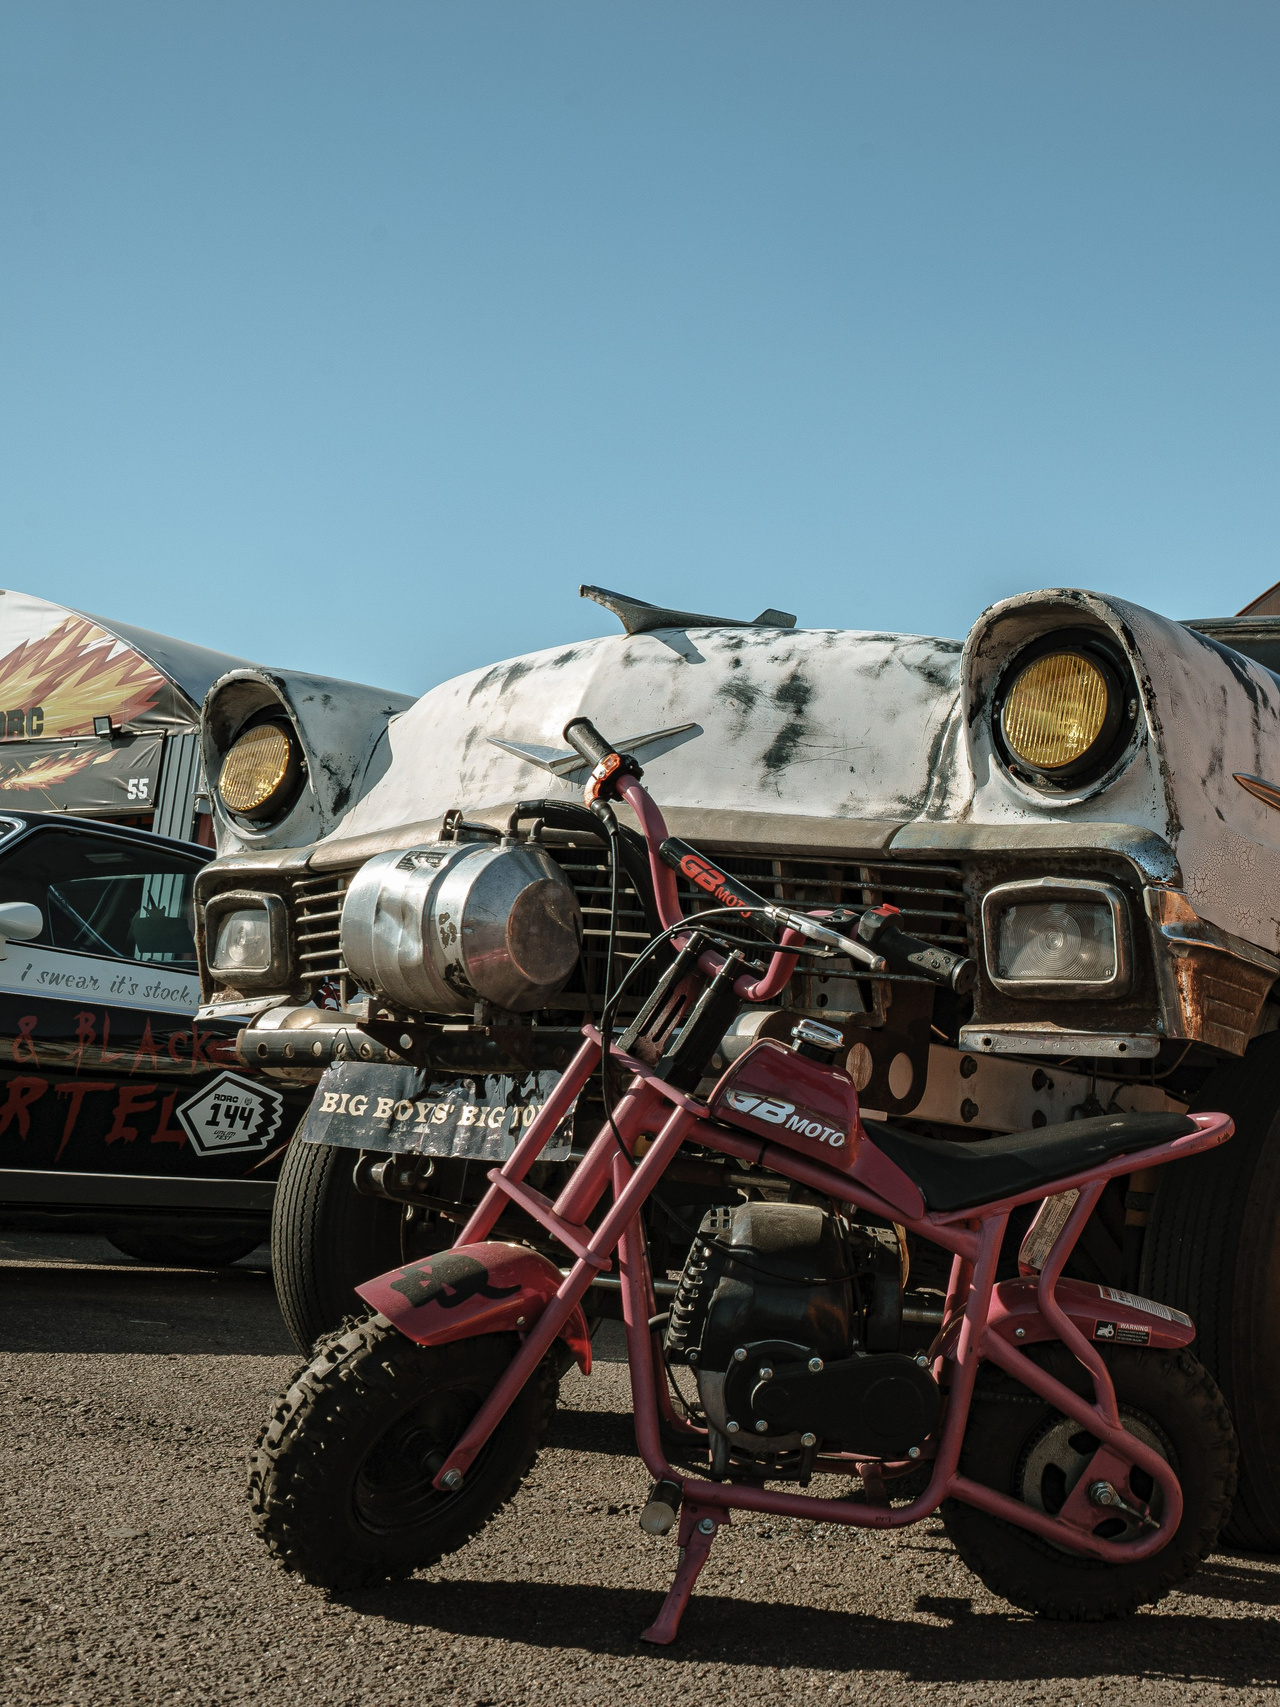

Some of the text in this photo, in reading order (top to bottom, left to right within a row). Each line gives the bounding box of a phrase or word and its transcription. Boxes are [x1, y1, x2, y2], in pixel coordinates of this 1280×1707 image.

[0, 706, 45, 742] RC
[127, 777, 150, 800] 55
[37, 969, 101, 991] swear
[109, 974, 140, 997] it's
[142, 980, 194, 1006] stock,
[11, 1014, 41, 1069] &
[213, 1093, 239, 1103] RDRC
[318, 1091, 370, 1117] BIG
[372, 1096, 455, 1125] BOYS'
[456, 1103, 508, 1129] BIG
[204, 1103, 255, 1131] 144
[784, 1114, 846, 1147] MOTO
[213, 1129, 237, 1137] UNLIM
[1120, 1323, 1149, 1332] WARNING
